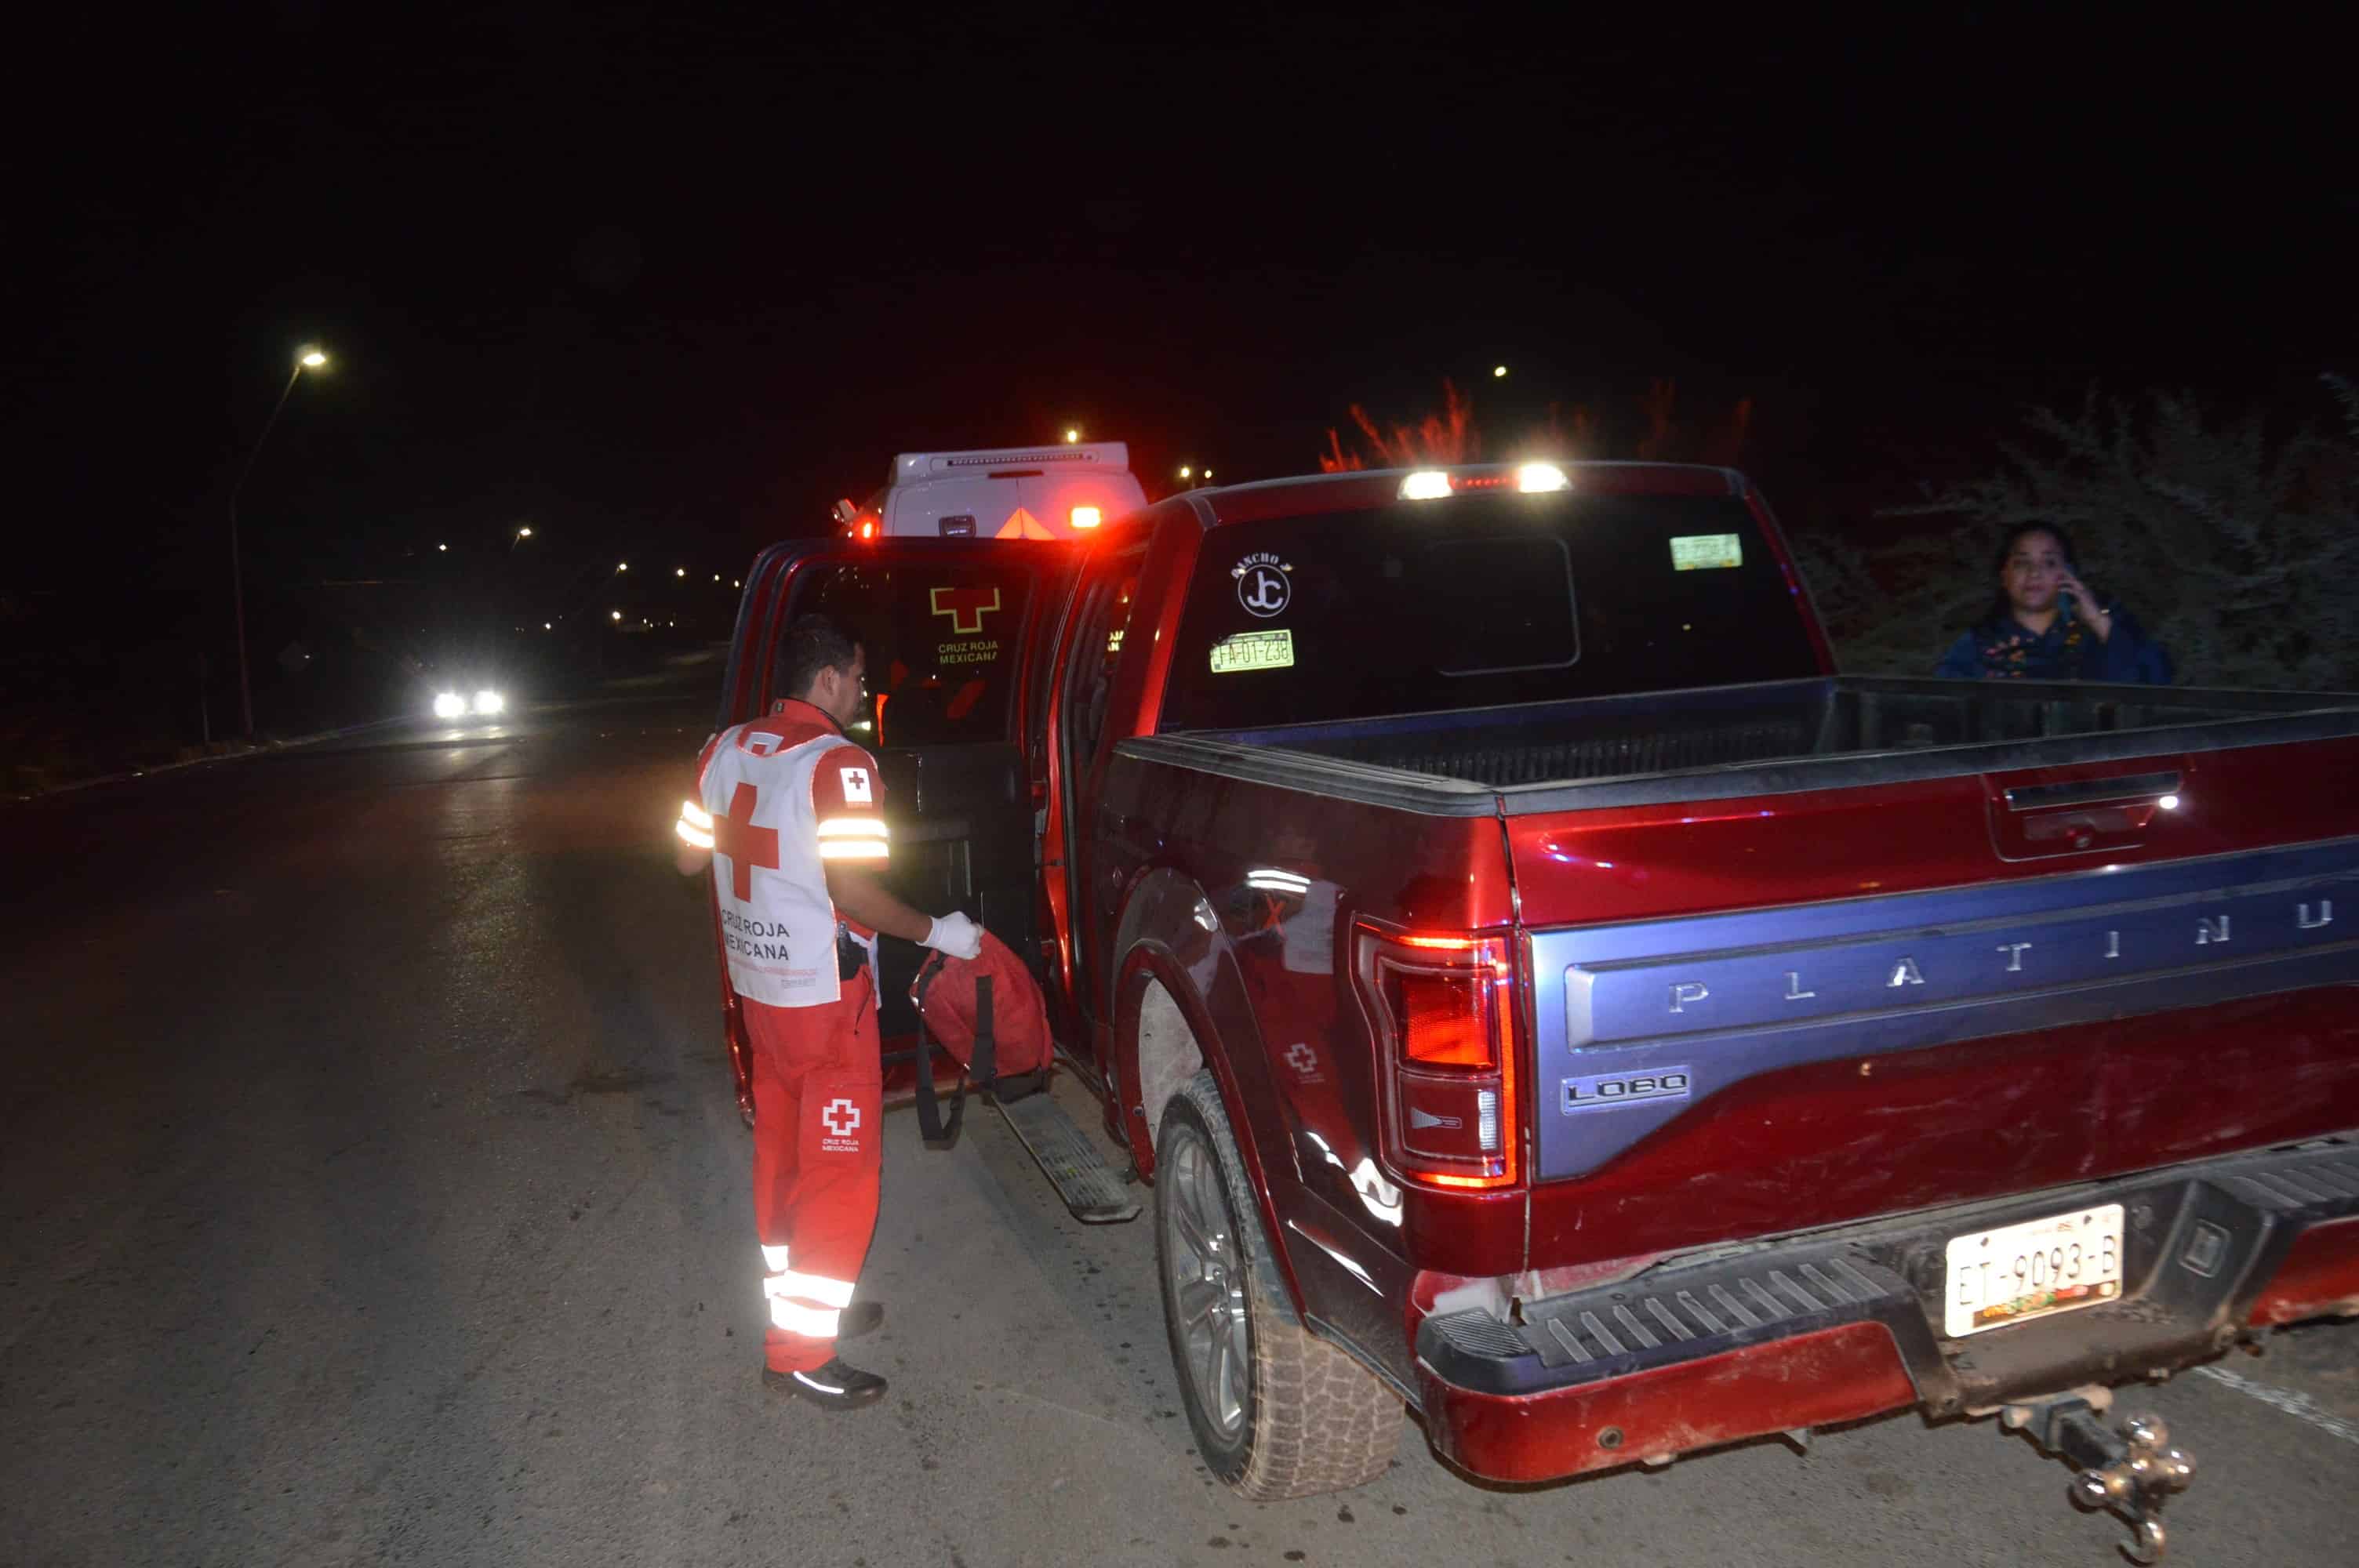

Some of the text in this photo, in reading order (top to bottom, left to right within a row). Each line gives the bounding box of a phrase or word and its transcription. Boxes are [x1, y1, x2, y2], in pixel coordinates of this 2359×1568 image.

[939, 641, 998, 653] CRUZ ROJA
[744, 918, 791, 938] ROJA
[1568, 1074, 1688, 1102] LOBO
[1960, 1234, 2116, 1306] ET-9093-B
